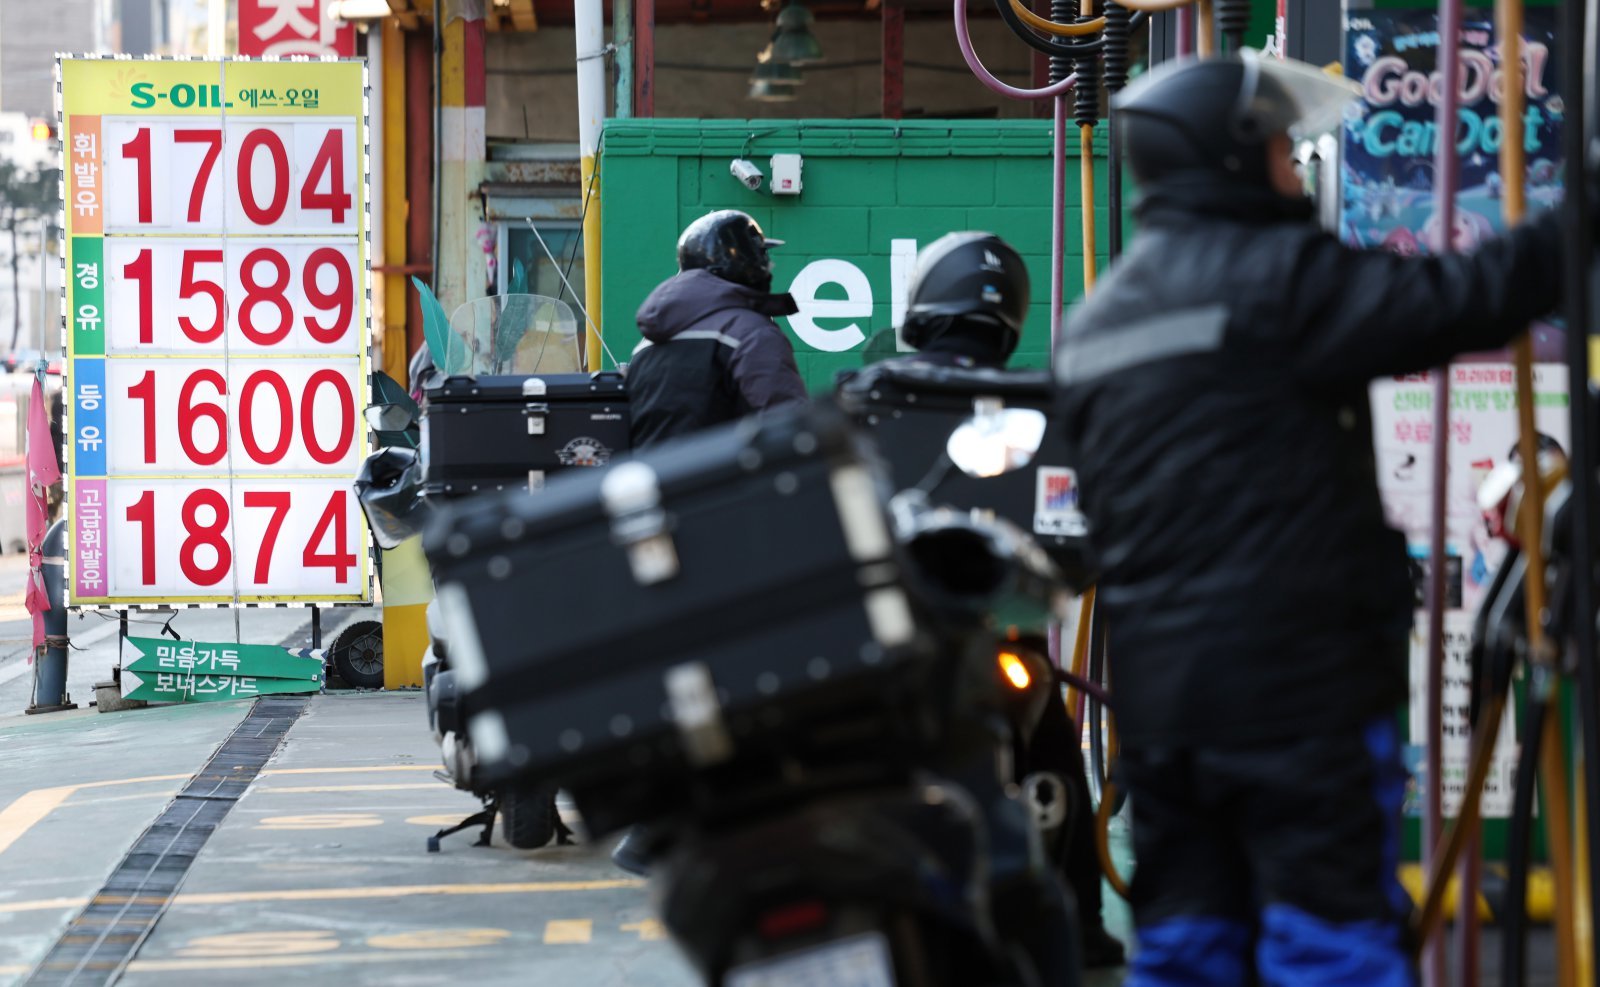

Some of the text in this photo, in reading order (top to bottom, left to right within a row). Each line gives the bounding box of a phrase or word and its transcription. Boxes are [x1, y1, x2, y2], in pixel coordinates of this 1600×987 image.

[131, 82, 233, 109] S-OIL
[239, 88, 319, 108] 에쓰-오일
[1363, 42, 1549, 108] GooDol
[73, 133, 99, 217] 휘발유
[122, 128, 352, 226] 1704
[76, 262, 101, 331] 경유
[123, 247, 354, 346] 1589
[77, 384, 102, 452] 등유
[127, 368, 356, 466] 1600
[79, 489, 103, 589] 고급휘발유
[126, 488, 357, 586] 1874
[154, 674, 260, 696] 보너스카드
[156, 645, 241, 671] 믿음가득
